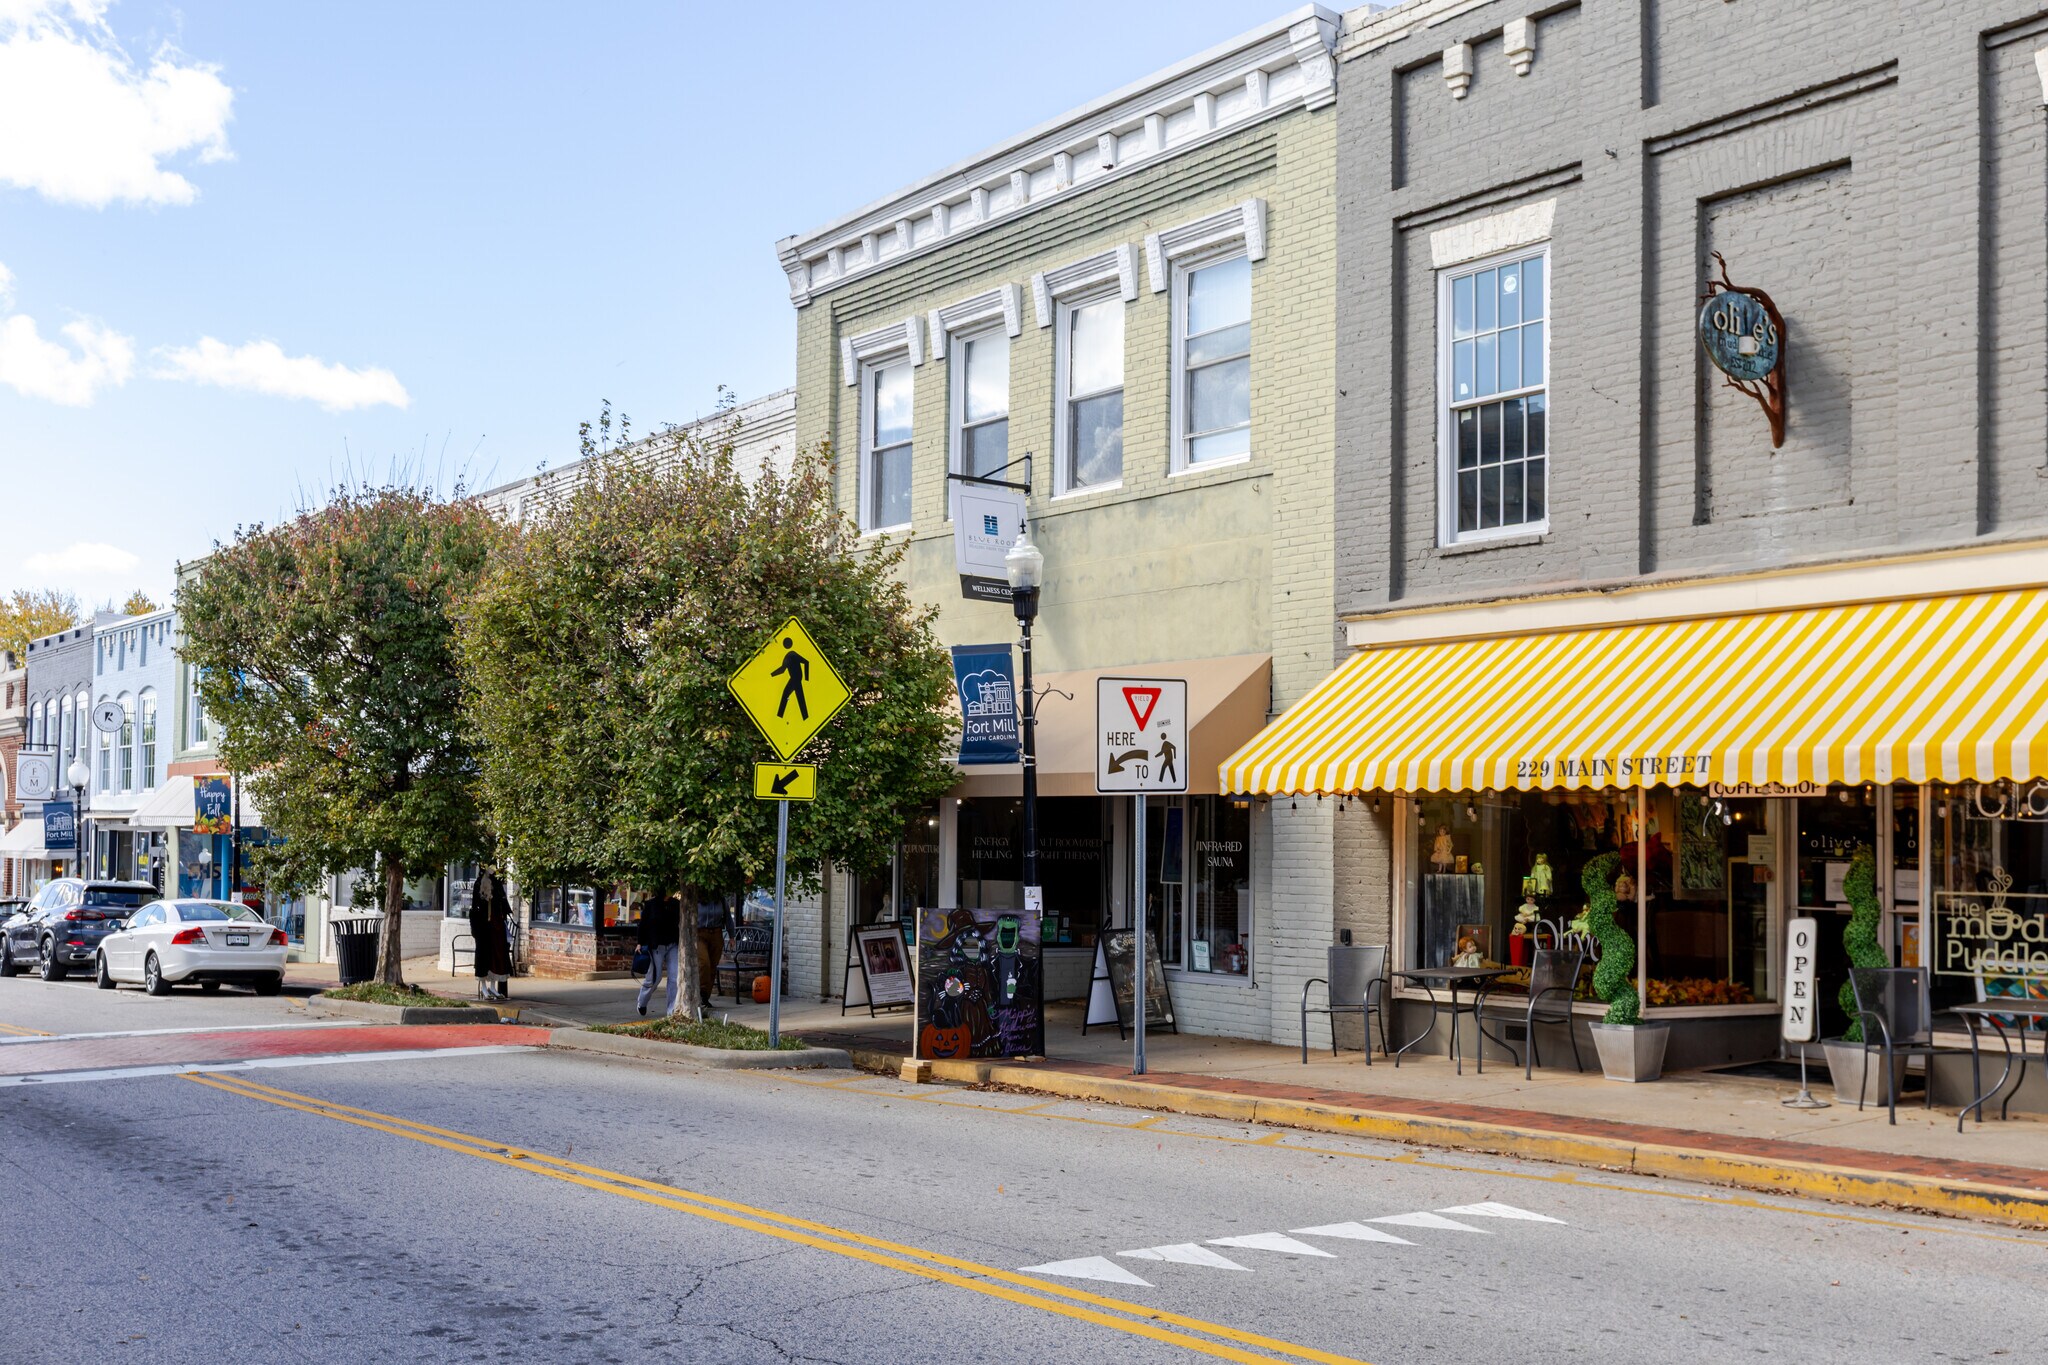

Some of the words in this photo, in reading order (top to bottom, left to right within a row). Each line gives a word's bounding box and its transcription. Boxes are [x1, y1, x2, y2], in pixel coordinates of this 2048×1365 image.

[968, 535, 990, 544] BLUE
[971, 584, 1000, 594] WELLNESS
[966, 720, 990, 734] Fort
[992, 718, 1016, 732] Mill
[1107, 731, 1136, 746] HERE
[1135, 764, 1149, 779] TO
[1516, 760, 1551, 778] 229
[1558, 758, 1615, 778] MAIN
[1621, 755, 1712, 776] STREET
[200, 786, 226, 803] Happy
[207, 803, 221, 817] Fall
[46, 831, 59, 839] Fort
[60, 830, 73, 838] Mill
[974, 837, 1010, 847] ENERGY
[1199, 840, 1243, 853] INFRA-RED
[971, 850, 1013, 860] HEALING
[1040, 850, 1059, 860] IGHT
[1207, 856, 1234, 867] SAUNA
[1033, 901, 1040, 910] 7
[1949, 898, 1980, 918] The
[1946, 939, 2048, 975] Puddle
[1789, 931, 1809, 1024] OPEN
